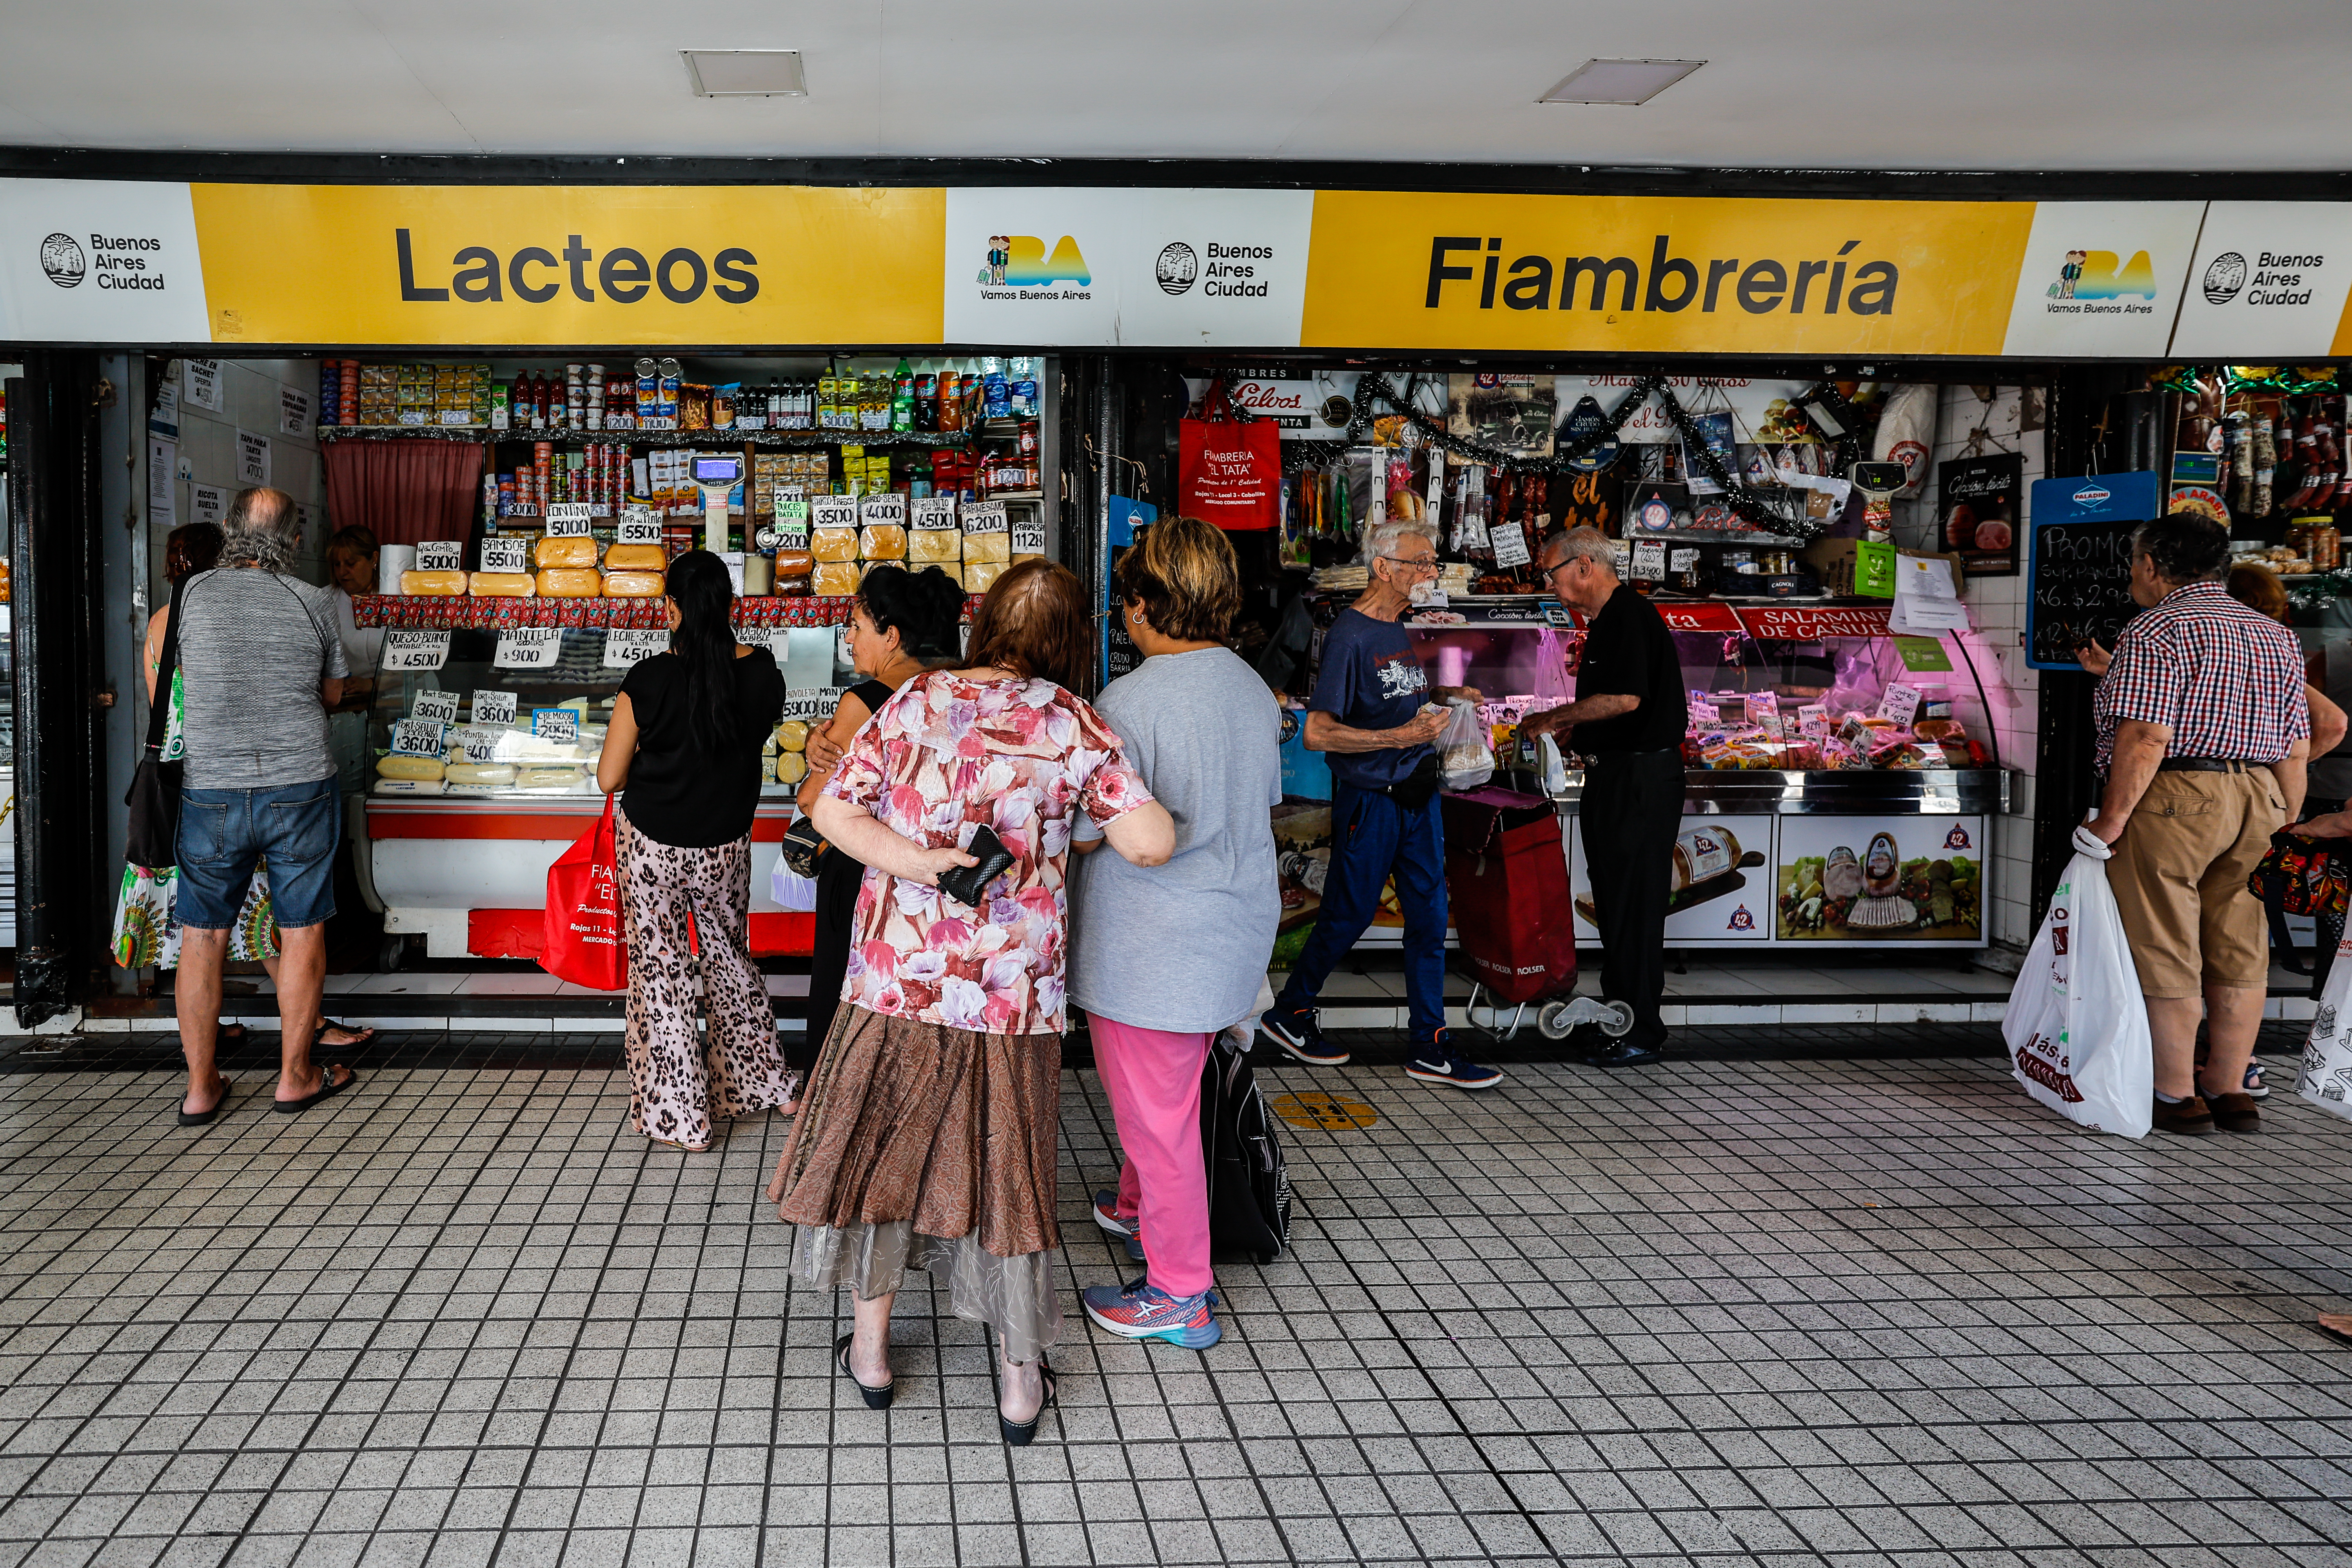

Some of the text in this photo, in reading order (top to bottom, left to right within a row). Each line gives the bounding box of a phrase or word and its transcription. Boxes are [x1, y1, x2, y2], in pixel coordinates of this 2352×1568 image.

[91, 234, 160, 250] Buenos
[1207, 242, 1273, 259] Buenos
[94, 254, 145, 270] Aires
[396, 227, 759, 304] Lacteos
[2258, 252, 2323, 268] Buenos
[1205, 262, 1254, 277] Aires
[1425, 234, 1899, 315] Fiambrería
[98, 273, 165, 290] Ciudad
[2251, 271, 2300, 287] Aires
[981, 290, 1091, 300] Vamos Buenos Aires
[1204, 281, 1268, 297] Ciudad
[2248, 289, 2312, 306] Ciudad
[2047, 303, 2153, 314] Vamos Buenos Aires
[209, 361, 218, 370] EN
[191, 365, 214, 379] SACHET
[195, 376, 211, 387] OFERTA
[608, 417, 633, 429] 1200
[824, 416, 852, 427] 3000
[241, 434, 267, 448] TAPA PARA
[246, 445, 261, 456] TARTA
[1204, 450, 1255, 462] FIAMBRERIA
[999, 470, 1026, 483] 1200
[198, 490, 218, 500] RICOTA
[2074, 491, 2109, 500] PALADINI
[198, 500, 218, 510] SUELTA
[510, 503, 537, 516] 3000
[777, 502, 801, 511] DULCES
[2192, 488, 2227, 519] ARABE
[483, 539, 525, 550] SAMSOE
[499, 630, 559, 641] MANTECA
[1759, 624, 1791, 637] DE
[512, 649, 540, 662] 900
[621, 648, 652, 661] 450
[1110, 652, 1130, 664] CRUDO
[1110, 664, 1131, 673] SARRIA
[422, 689, 457, 701] PORT SALUT
[786, 688, 815, 699] PROVOLETA
[537, 712, 573, 720] CREMOSO
[1697, 839, 1712, 851] 42
[1951, 833, 1964, 846] 42
[577, 903, 613, 915] Productos
[1735, 914, 1747, 926] 42
[570, 922, 591, 933] Rojas
[582, 936, 613, 945] MERCADO
[1492, 963, 1545, 975] ROLSER ROLSER
[1181, 1311, 1196, 1323] ATHIX
